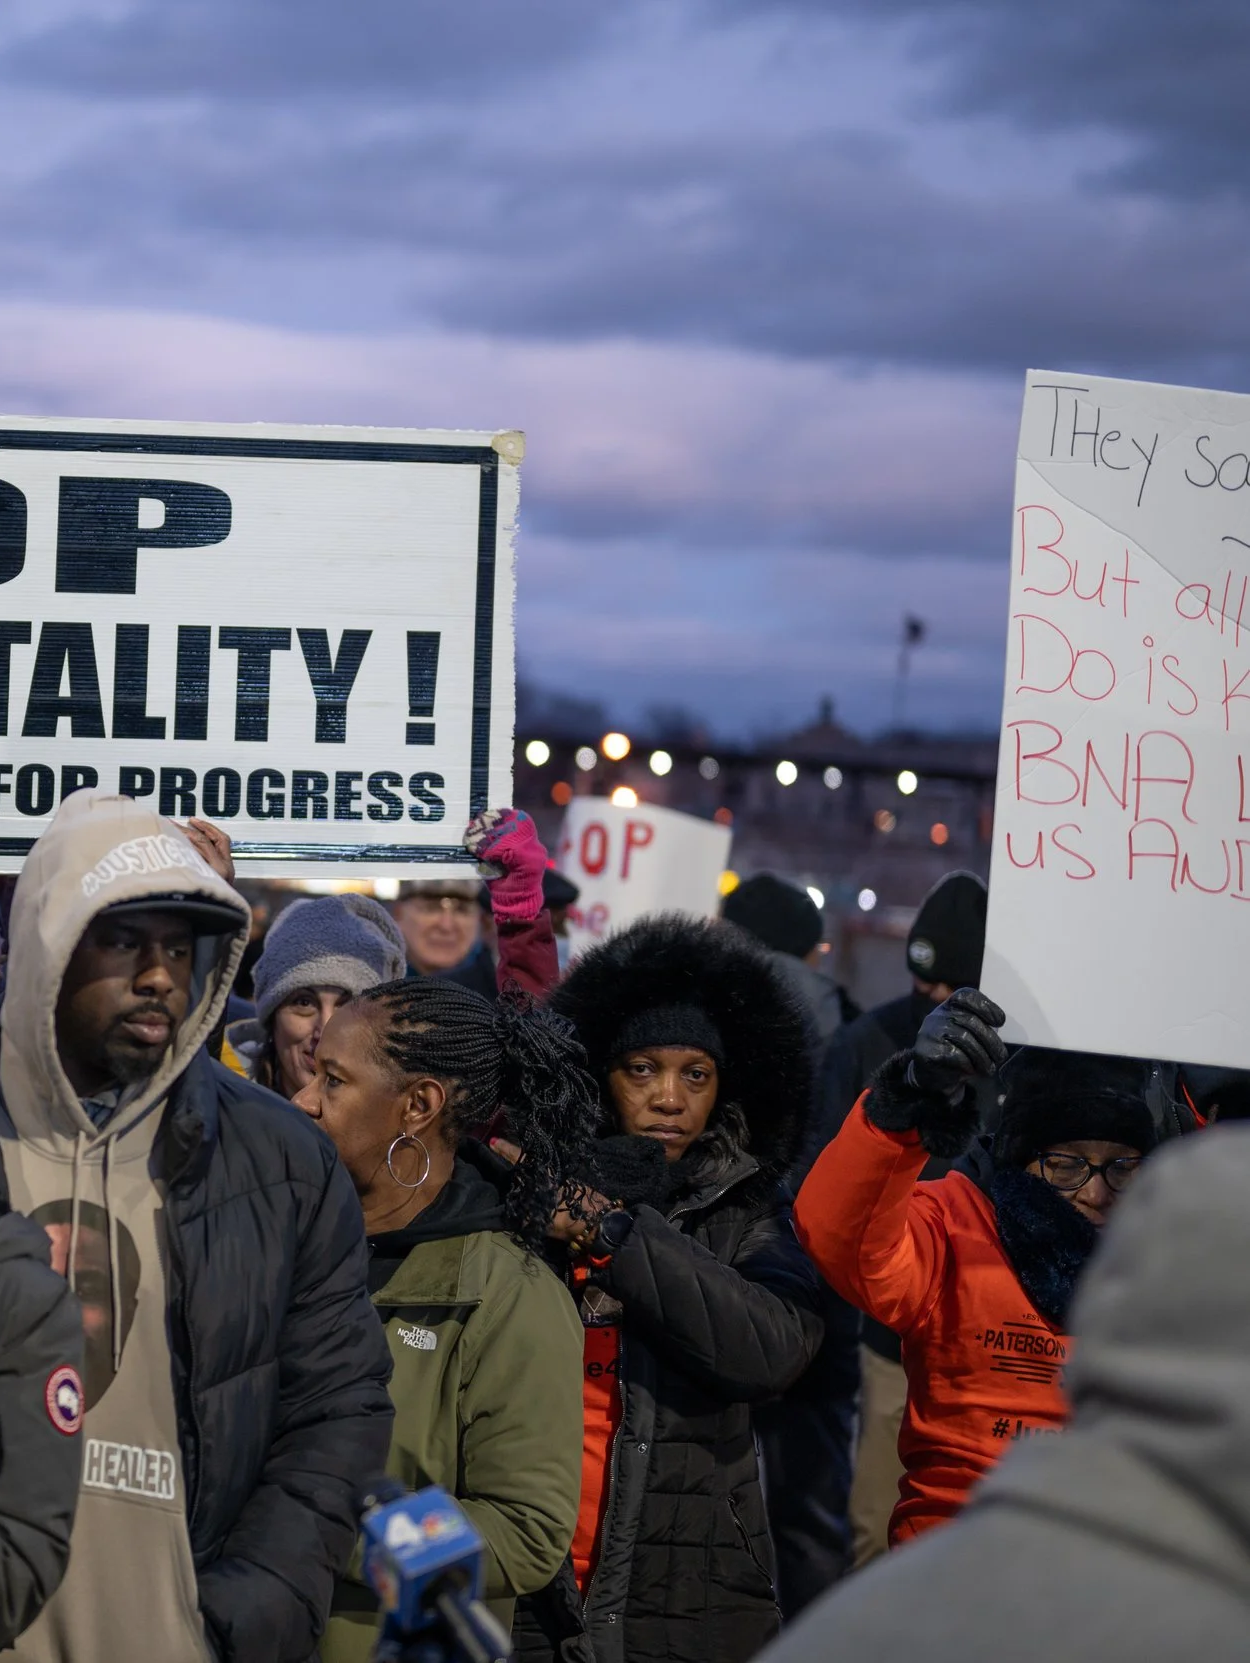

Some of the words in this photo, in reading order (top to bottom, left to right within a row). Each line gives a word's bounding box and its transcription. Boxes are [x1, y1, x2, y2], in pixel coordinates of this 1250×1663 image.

[1016, 505, 1140, 618] But
[1175, 570, 1248, 648] all
[118, 766, 446, 825] PROGRESS
[1006, 719, 1199, 825] BNA
[564, 819, 655, 882] OP
[397, 1327, 426, 1343] NORTH
[402, 1337, 425, 1350] FACE
[412, 1325, 428, 1337] THE
[983, 1329, 1066, 1359] PATERSON
[82, 1439, 176, 1500] HEALER
